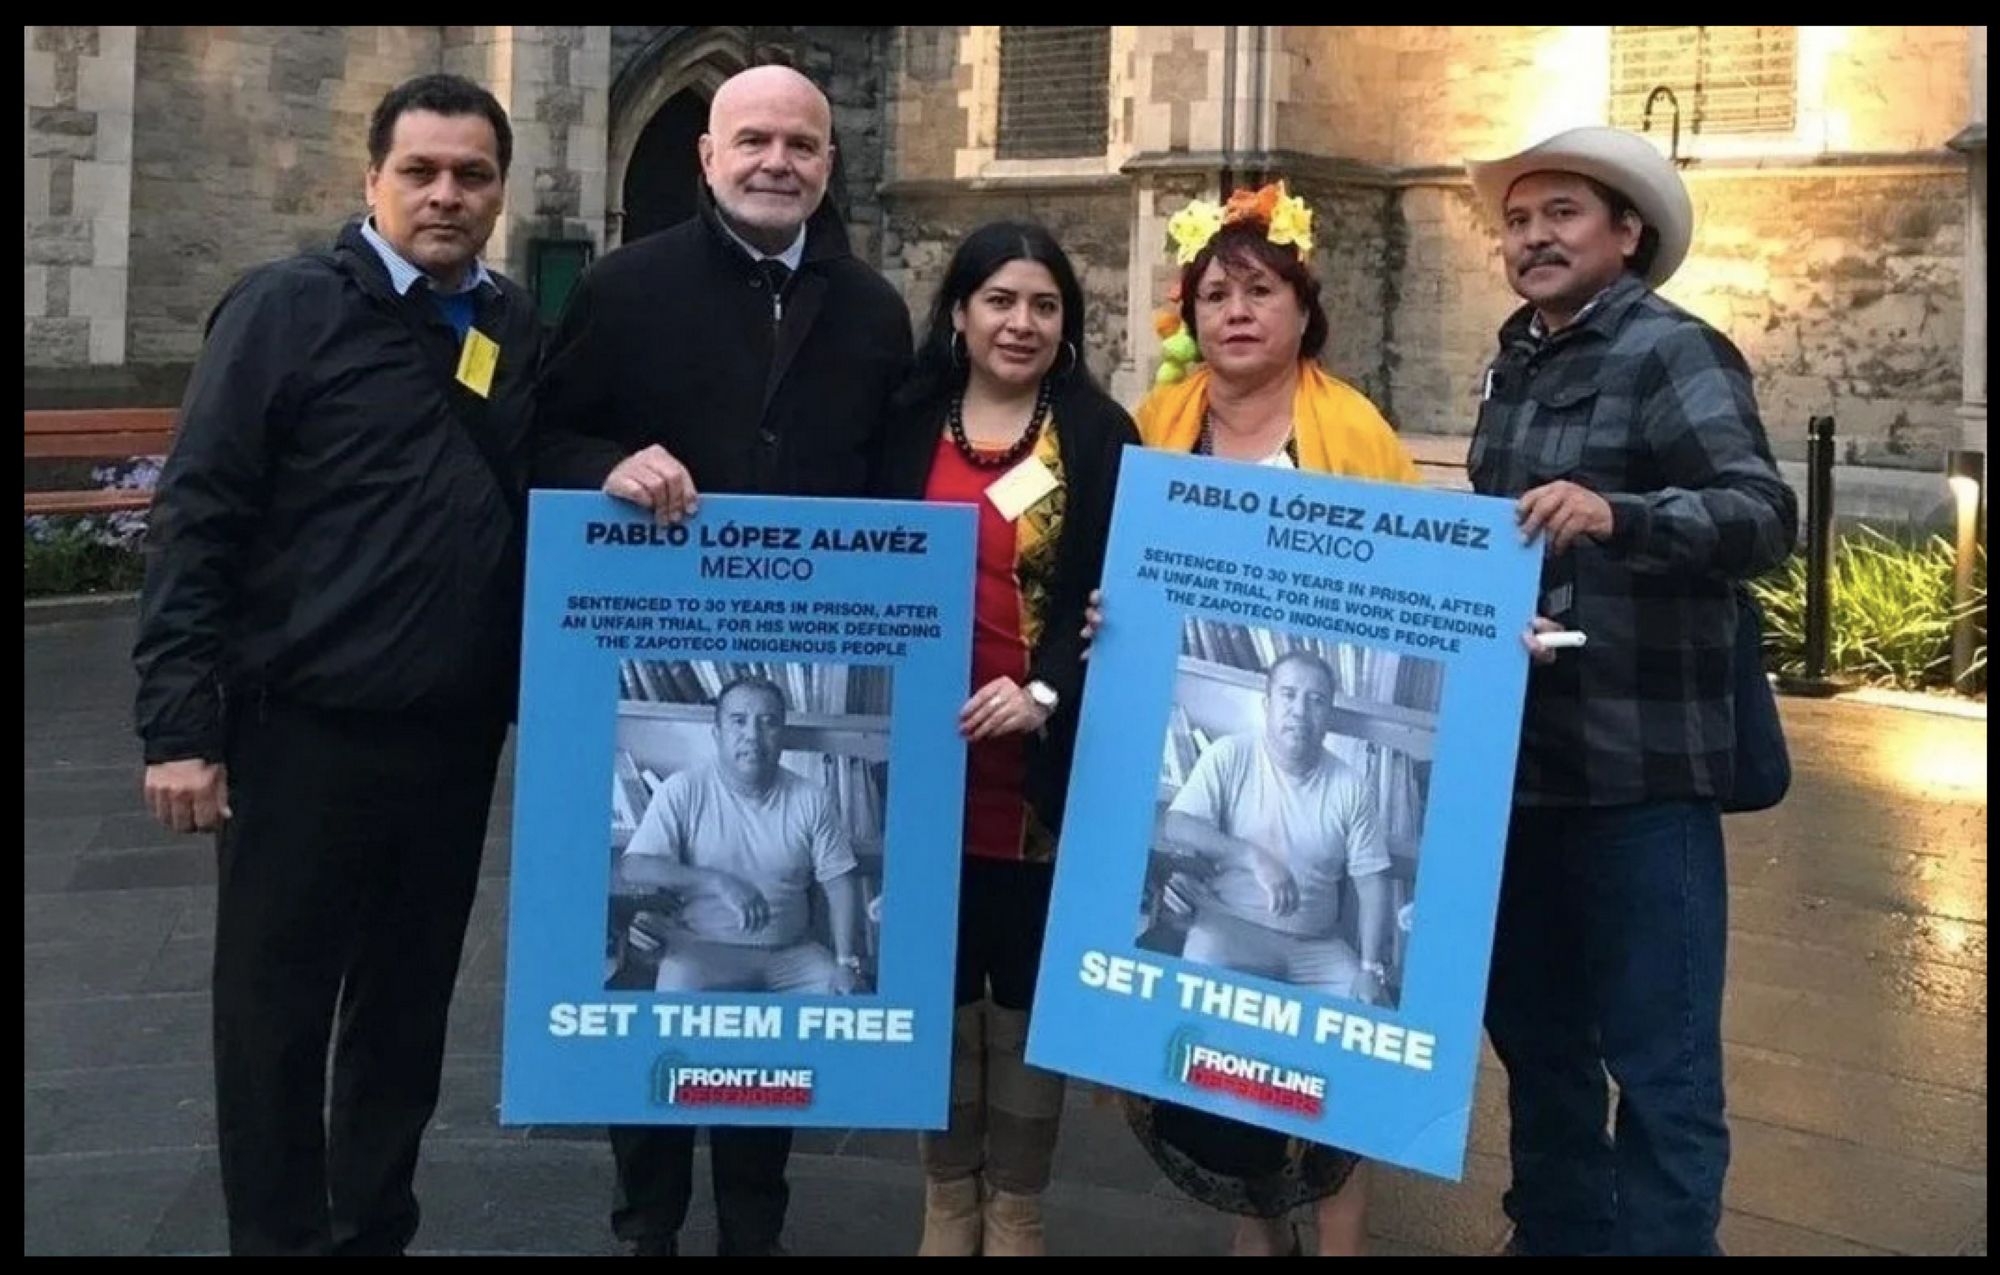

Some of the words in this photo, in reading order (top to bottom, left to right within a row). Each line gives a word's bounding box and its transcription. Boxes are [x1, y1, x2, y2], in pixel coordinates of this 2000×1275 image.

[1168, 480, 1260, 513] PABLO
[1269, 495, 1366, 530] LÓPEZ
[1373, 513, 1491, 550] ALAVÉZ
[586, 522, 689, 546] PABLO
[701, 520, 801, 549] LÓPEZ
[811, 525, 927, 554] ALAVÉZ
[1266, 525, 1375, 563] MEXICO
[701, 556, 814, 580] MEXICO
[1144, 548, 1237, 575] SENTENCED
[1242, 564, 1263, 579] TO
[1267, 569, 1287, 583] 30
[1292, 572, 1344, 593] YEARS
[1348, 581, 1366, 596] IN
[1370, 584, 1436, 610] PRISON,
[1440, 597, 1495, 618] AFTER
[567, 596, 671, 611] SENTENCED
[676, 598, 700, 612] TO
[705, 599, 726, 612] 30
[731, 599, 785, 613] YEARS
[791, 601, 808, 614] IN
[813, 602, 880, 618] PRISON,
[884, 604, 939, 619] AFTER
[1137, 565, 1159, 580] AN
[1163, 569, 1220, 590] UNFAIR
[1223, 579, 1271, 601] TRIAL,
[1276, 589, 1308, 606] FOR
[1313, 595, 1340, 612] HIS
[1345, 601, 1395, 622] WORK
[1399, 611, 1497, 639] DEFENDING
[1165, 588, 1196, 606] THE
[1199, 595, 1285, 621] ZAPOTECO
[1289, 611, 1390, 640] INDIGENOUS
[1394, 629, 1461, 653] PEOPLE
[562, 615, 586, 629] AN
[591, 616, 653, 630] UNFAIR
[658, 617, 710, 632] TRIAL,
[717, 619, 750, 632] FOR
[756, 620, 784, 633] HIS
[789, 621, 840, 635] WORK
[845, 623, 941, 638] DEFENDING
[595, 635, 630, 649] THE
[634, 636, 728, 650] ZAPOTECO
[733, 637, 836, 653] INDIGENOUS
[842, 641, 907, 656] PEOPLE
[549, 1003, 637, 1037] SET
[652, 1005, 782, 1039] THEM
[798, 1007, 914, 1042] FREE
[1079, 950, 1163, 999] SET
[1175, 972, 1301, 1038] THEM
[1314, 1007, 1437, 1071] FREE
[678, 1068, 757, 1086] FRONT
[760, 1069, 813, 1088] LINE
[1192, 1045, 1272, 1084] FRONT
[1270, 1066, 1326, 1099] LINE
